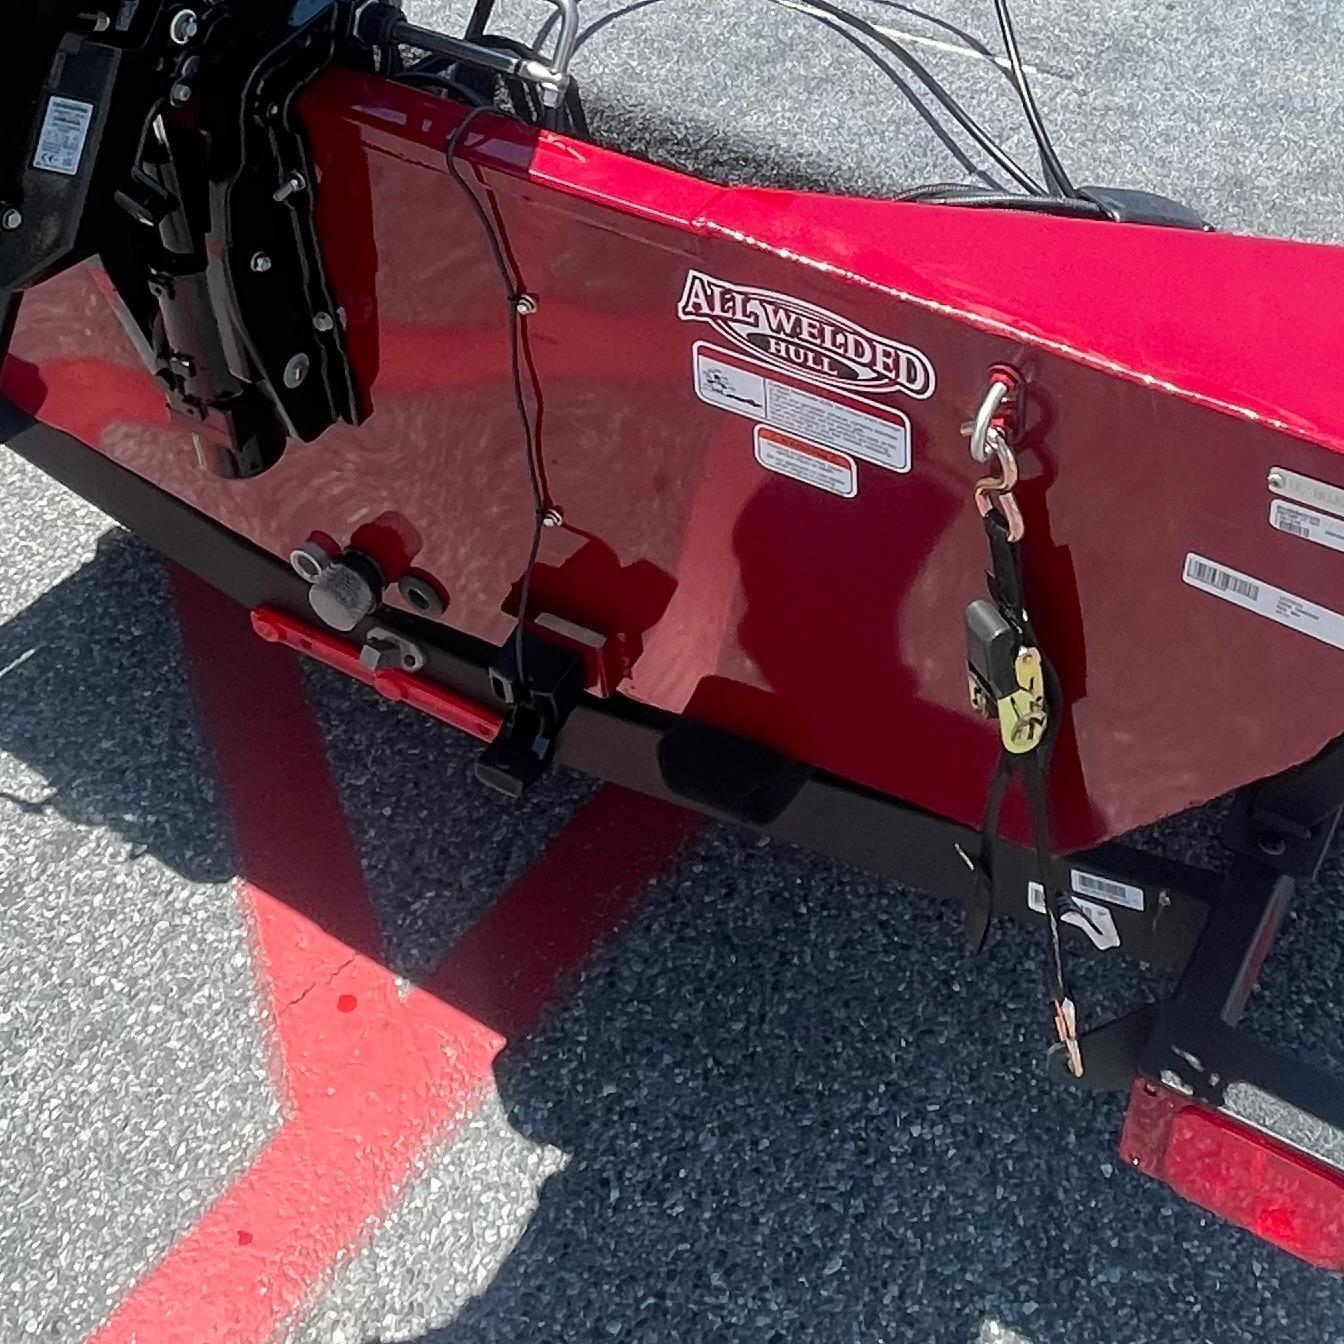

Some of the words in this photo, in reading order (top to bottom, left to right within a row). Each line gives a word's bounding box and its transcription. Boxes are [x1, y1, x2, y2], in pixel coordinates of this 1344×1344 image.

[684, 276, 755, 323] ALL
[762, 301, 927, 391] WELDED
[767, 337, 839, 376] HULL
